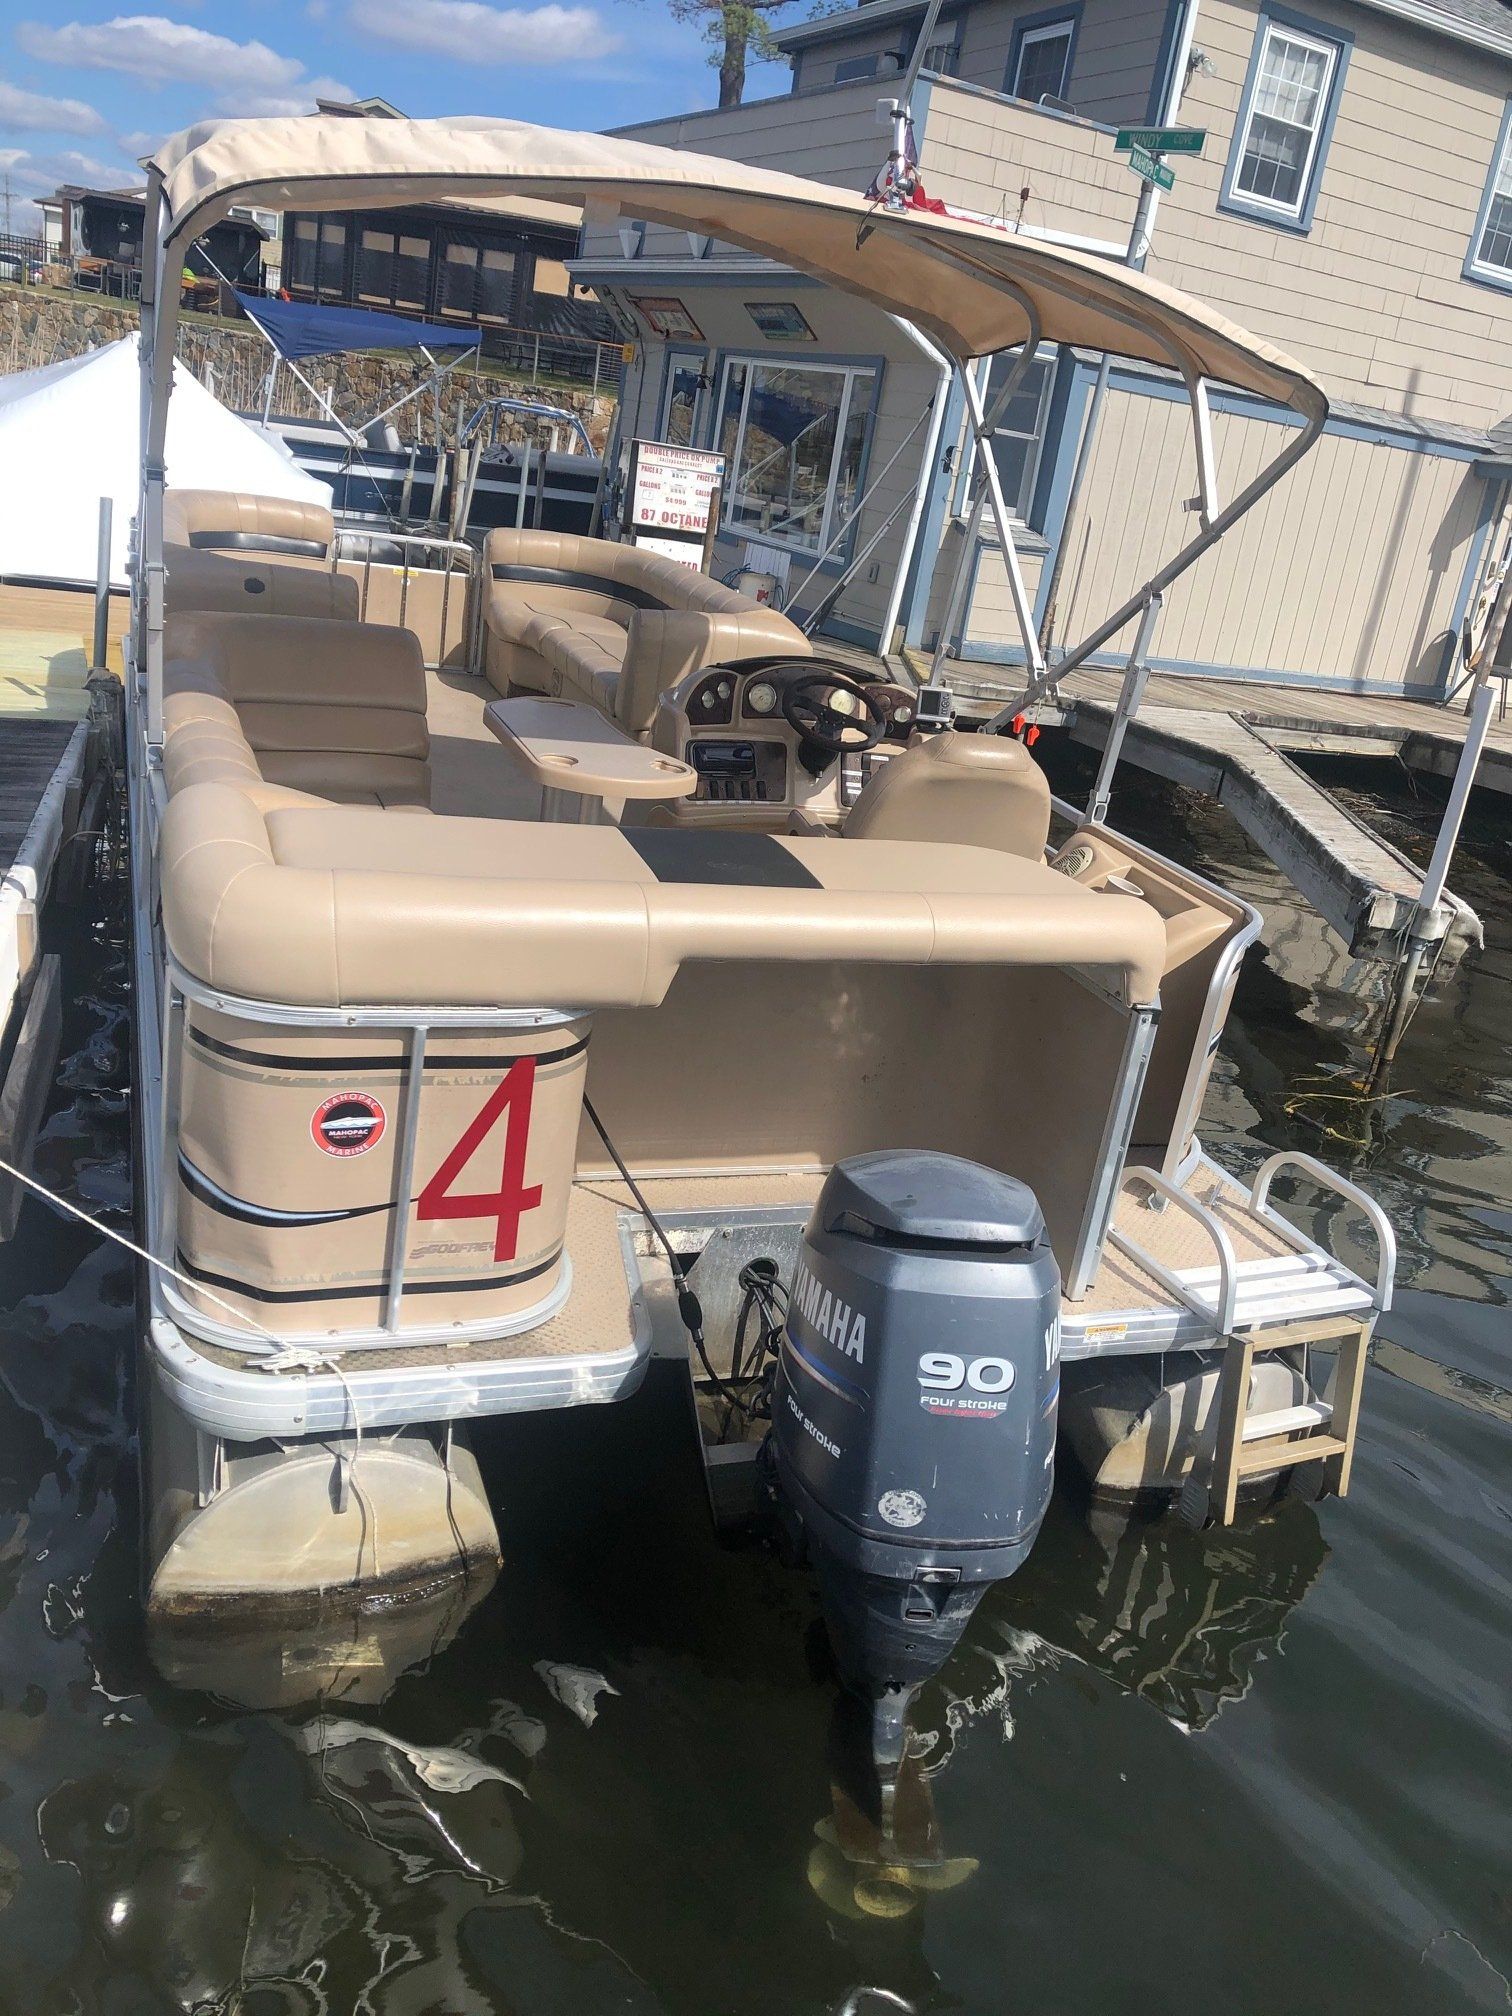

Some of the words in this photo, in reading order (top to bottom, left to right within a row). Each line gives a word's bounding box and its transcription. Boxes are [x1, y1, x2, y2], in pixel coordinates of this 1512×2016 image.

[1129, 133, 1163, 148] WINDY
[1173, 134, 1194, 145] COVE
[644, 446, 669, 457] DOUBLE
[670, 450, 690, 460] PRICE
[702, 456, 720, 465] PUMP
[641, 465, 656, 474] PRICE
[639, 480, 661, 490] GALLONS
[696, 474, 711, 483] PRICE
[695, 489, 712, 498] GALLO
[641, 508, 656, 521] 87
[661, 511, 708, 528] OCTANE
[322, 1093, 377, 1110] MAHOPAC
[325, 1142, 369, 1156] MARINE
[417, 1057, 543, 1262] 4
[794, 1260, 866, 1364] YAMAHA
[917, 1352, 1015, 1394] 90
